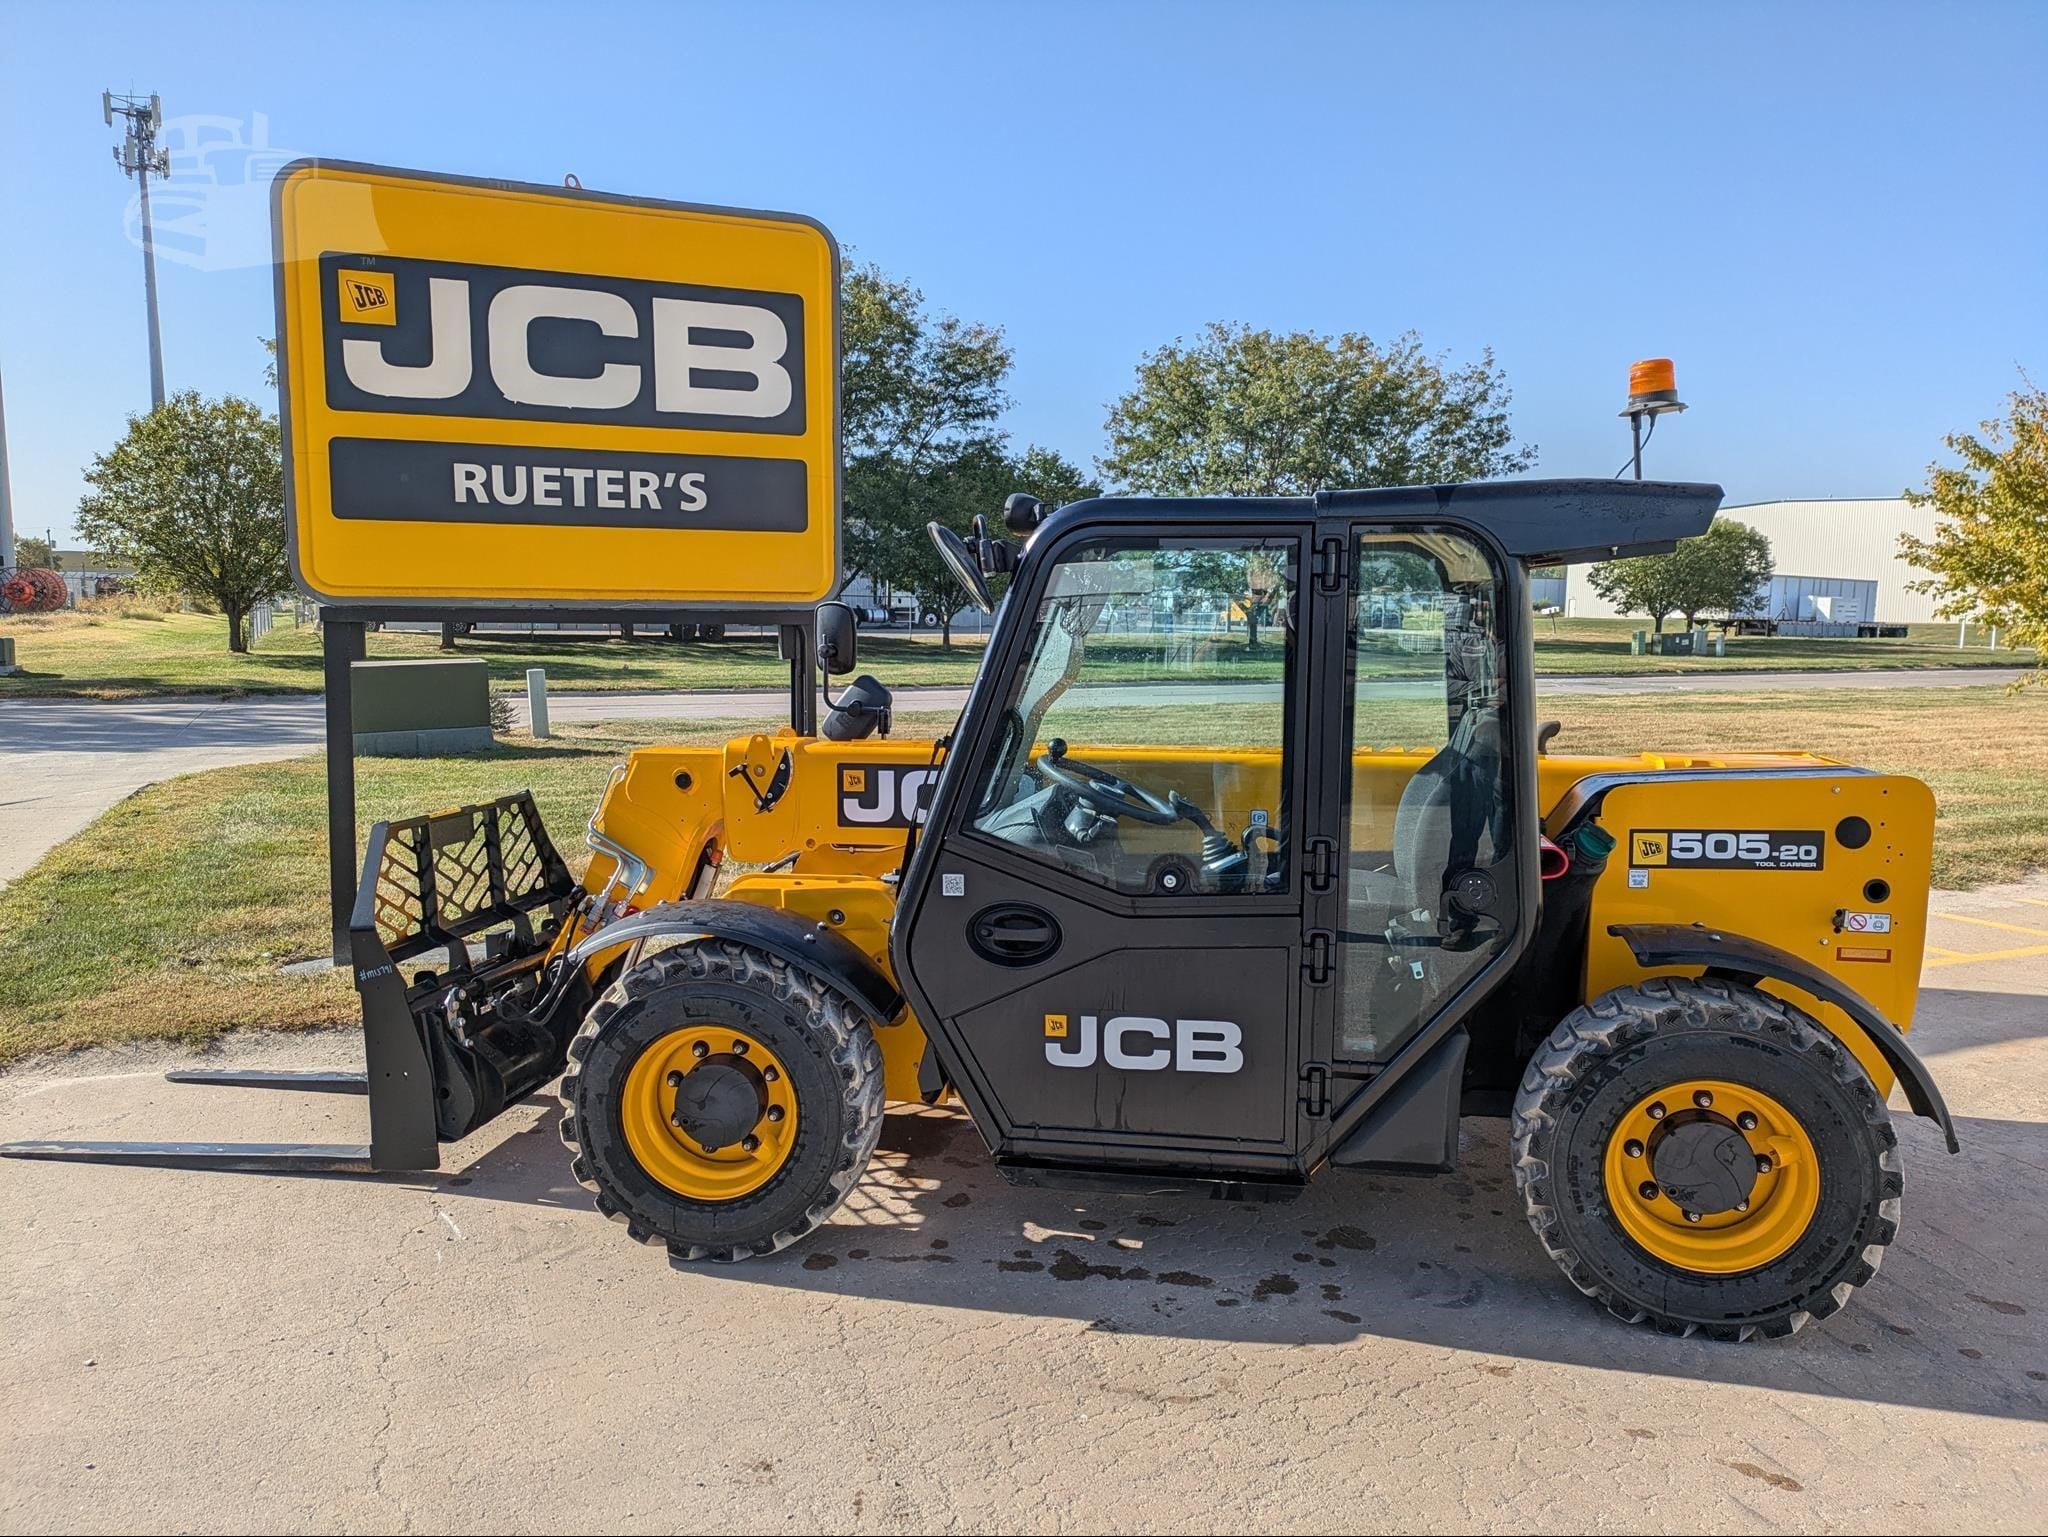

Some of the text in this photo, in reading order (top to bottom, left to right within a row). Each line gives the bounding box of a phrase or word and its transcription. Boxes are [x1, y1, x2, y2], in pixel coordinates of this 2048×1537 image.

[354, 284, 386, 309] JCB
[342, 277, 793, 419] JCB
[453, 462, 708, 512] RUETER'S
[843, 769, 939, 823] JC
[1641, 842, 1663, 855] JCB
[1670, 832, 1818, 861] 505-20
[1045, 1015, 1244, 1074] JCB
